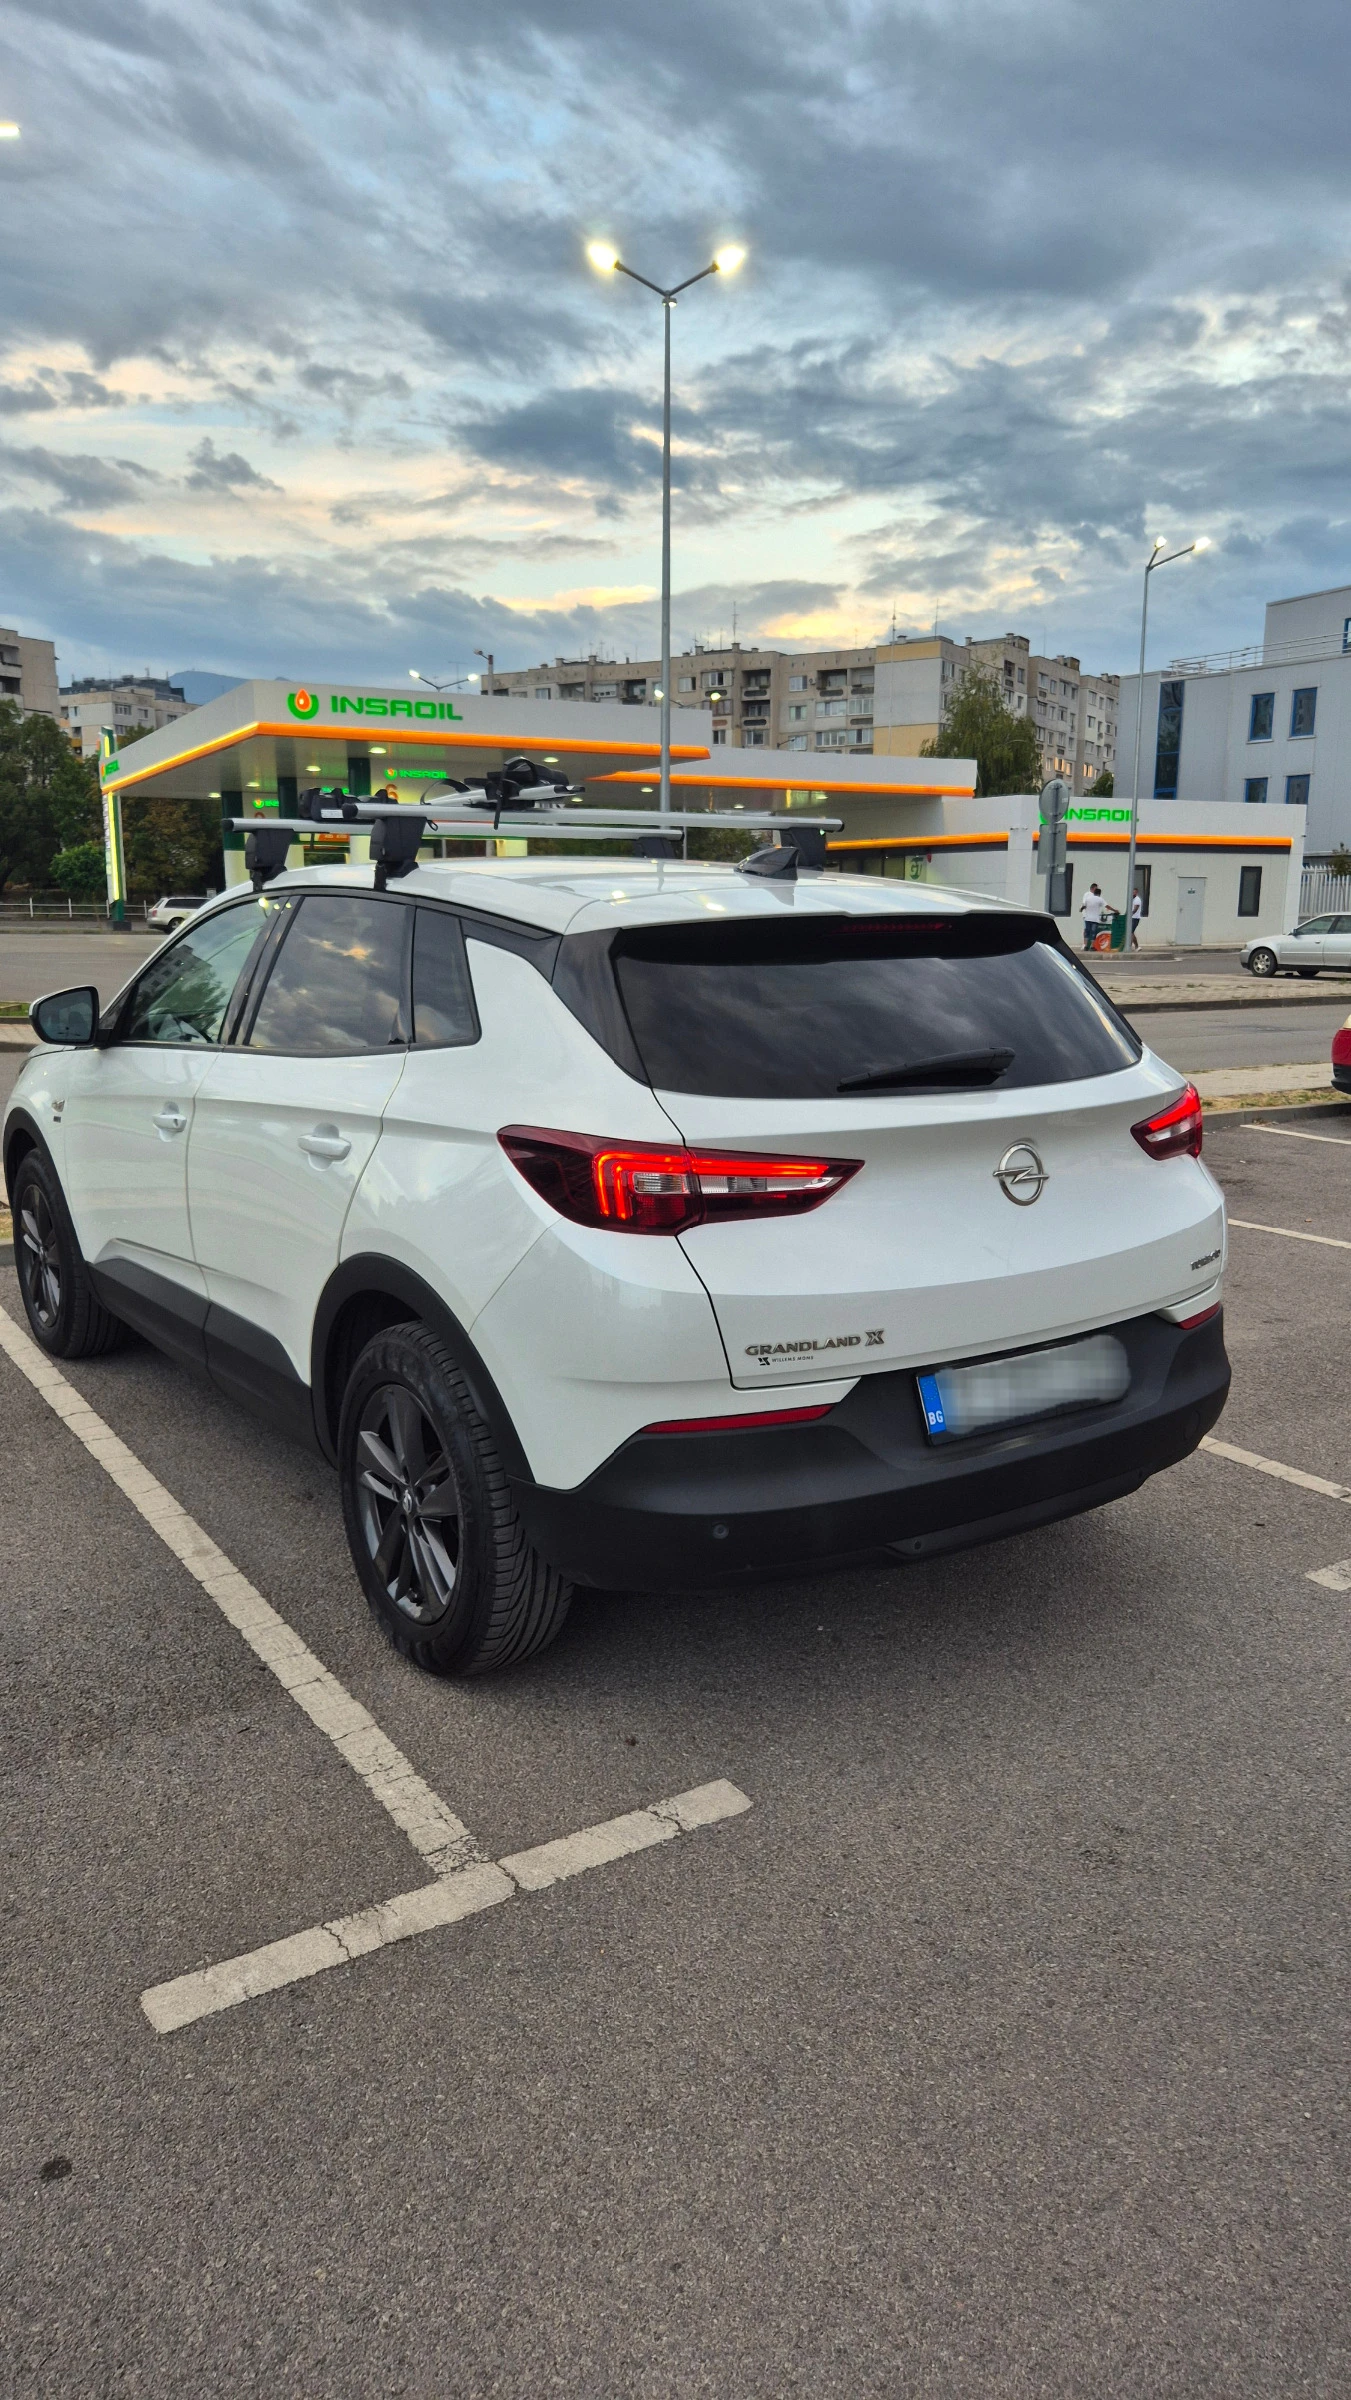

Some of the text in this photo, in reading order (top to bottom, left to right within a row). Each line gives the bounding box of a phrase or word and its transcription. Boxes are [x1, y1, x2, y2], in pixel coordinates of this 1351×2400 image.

[331, 695, 463, 721] INSAOIL
[745, 1329, 885, 1356] GRANDLAND X
[928, 1410, 943, 1425] BG
